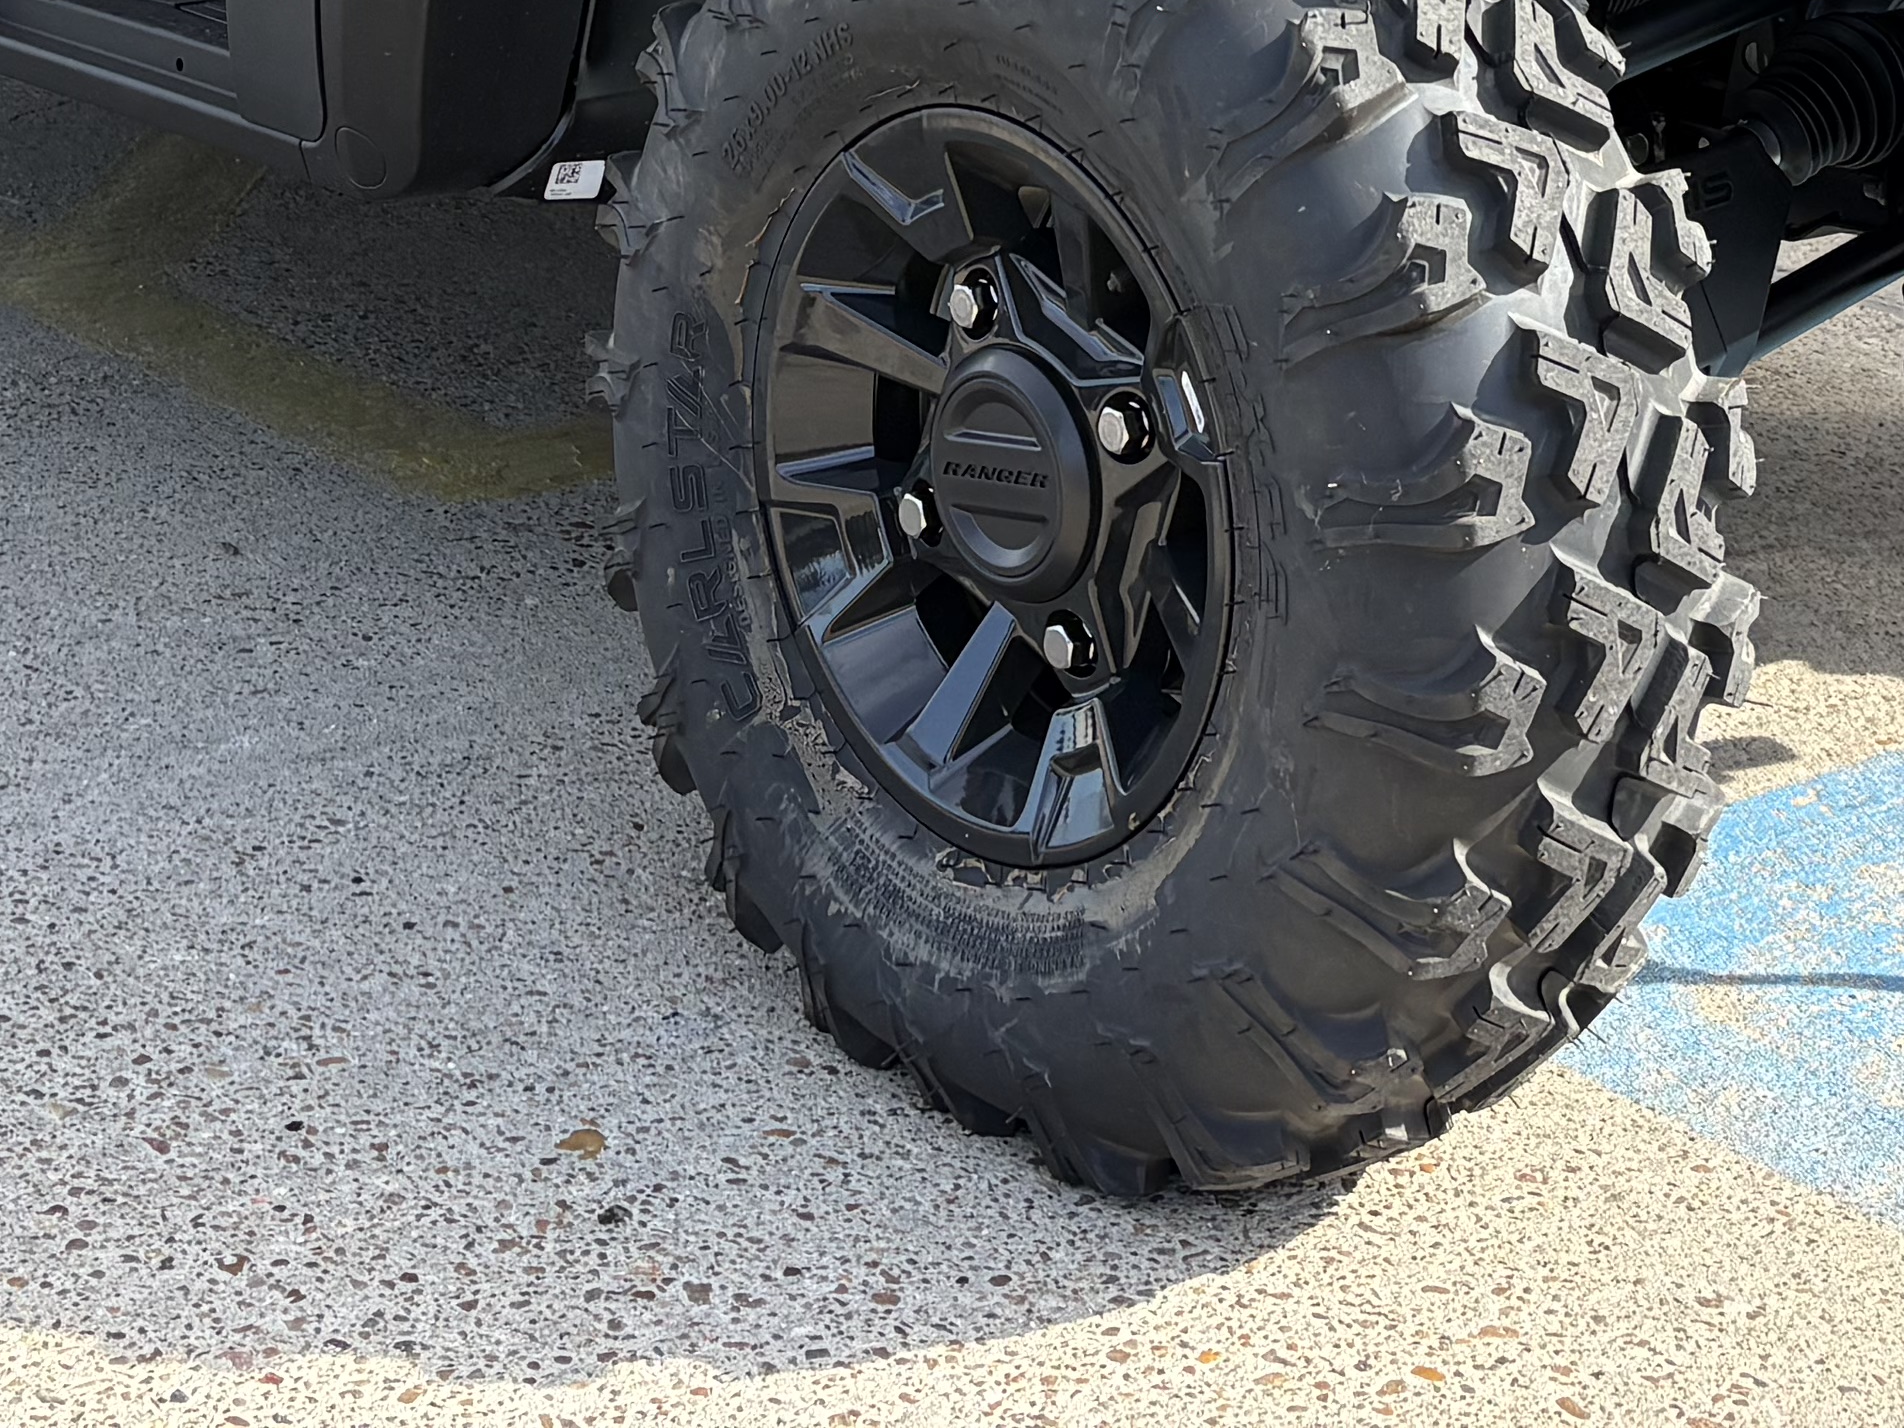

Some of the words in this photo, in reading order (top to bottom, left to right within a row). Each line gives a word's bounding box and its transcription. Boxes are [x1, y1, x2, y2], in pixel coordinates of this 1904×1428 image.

[810, 22, 854, 66] NHS
[942, 460, 1049, 489] RANGER
[665, 310, 764, 722] CARLSTAR
